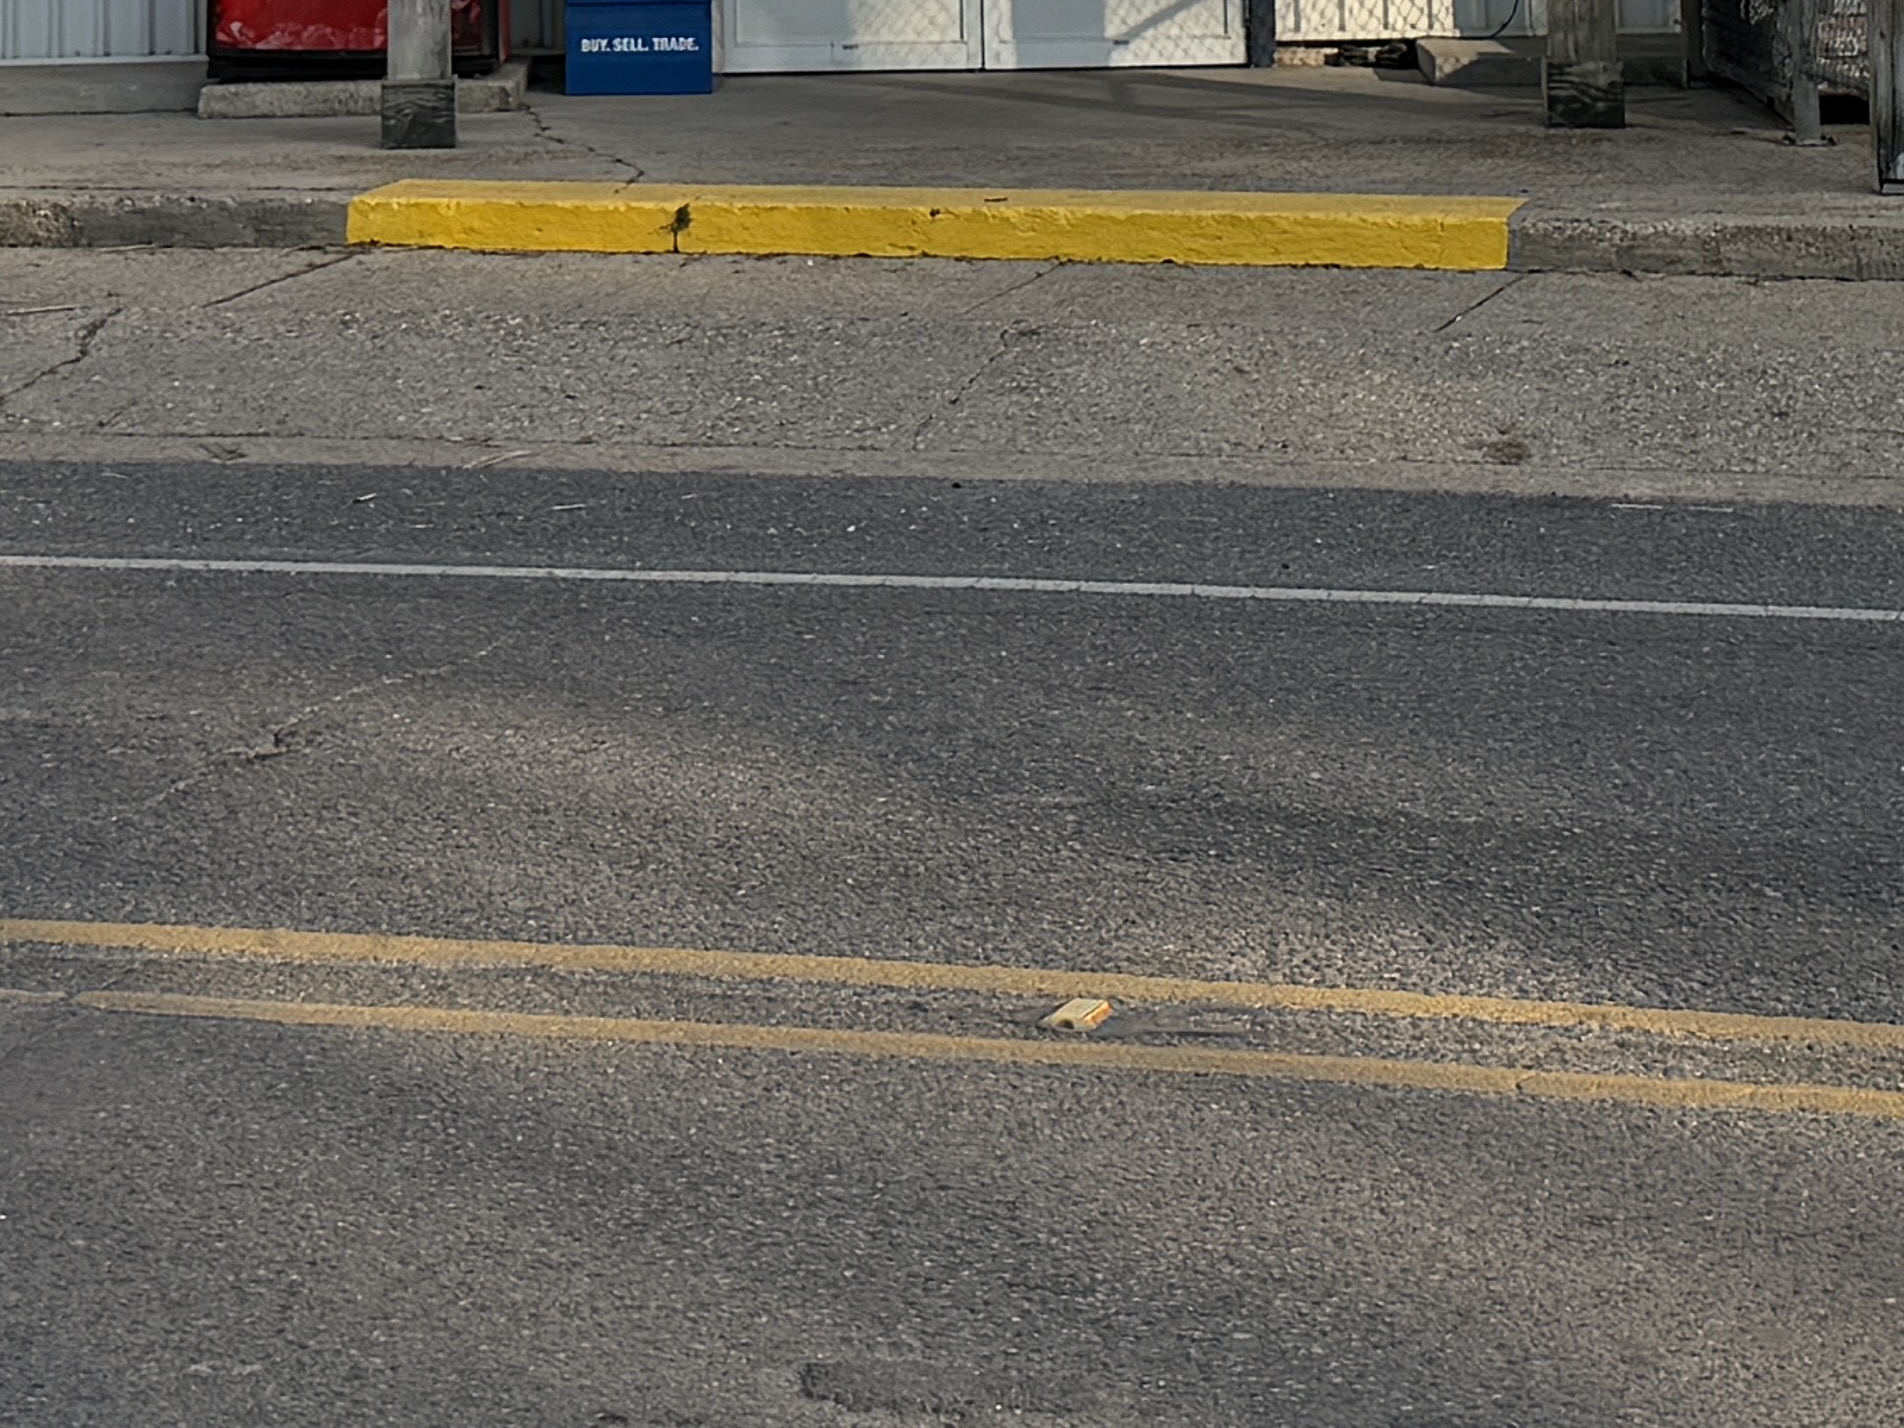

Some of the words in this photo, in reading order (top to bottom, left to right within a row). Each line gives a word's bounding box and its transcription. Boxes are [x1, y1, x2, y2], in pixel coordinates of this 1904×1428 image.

[581, 38, 611, 52] BUY.
[612, 37, 649, 52] SELL.
[652, 37, 700, 51] TRADE.
